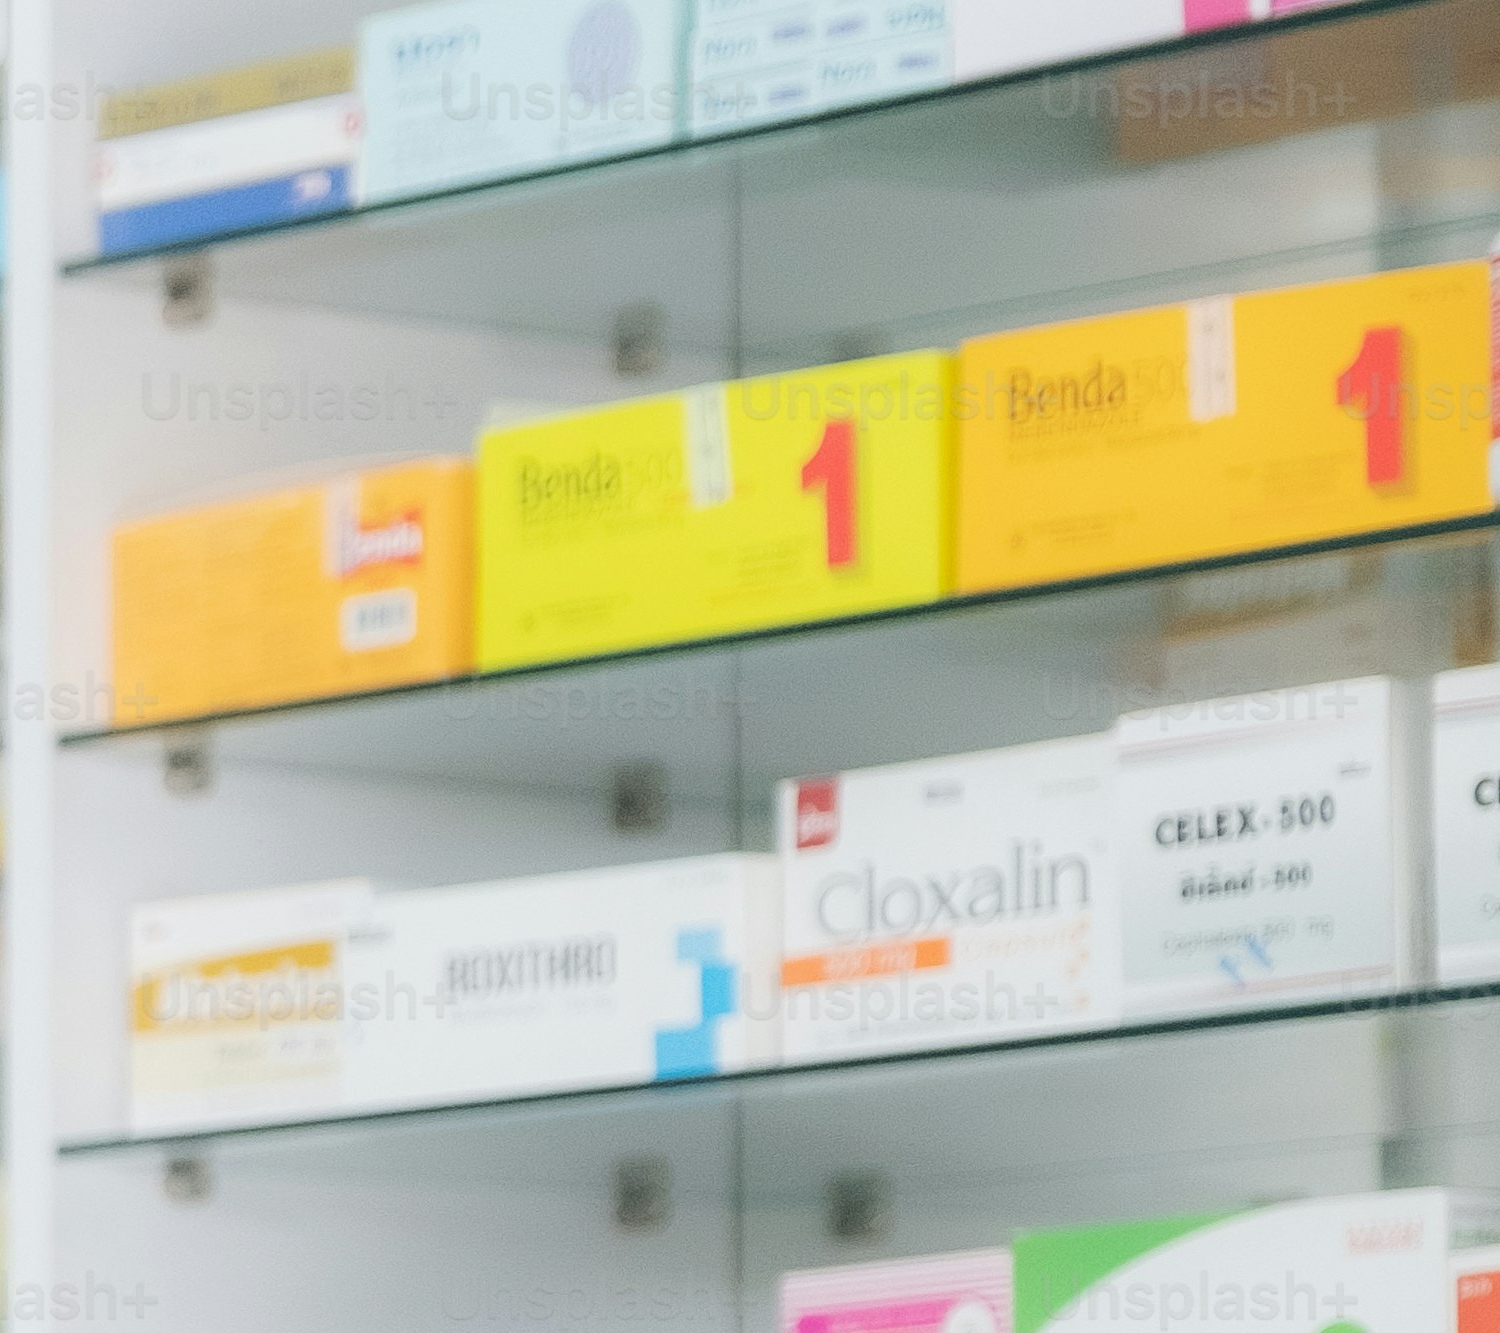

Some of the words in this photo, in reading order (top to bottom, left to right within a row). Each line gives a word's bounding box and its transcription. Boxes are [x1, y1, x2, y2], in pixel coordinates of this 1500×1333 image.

[1008, 357, 1128, 422] Benda
[1336, 324, 1404, 487] 1
[519, 448, 622, 510] Benda
[801, 421, 857, 568] 1
[815, 838, 1092, 942] Cloxalin
[445, 935, 617, 998] ROXITHRO
